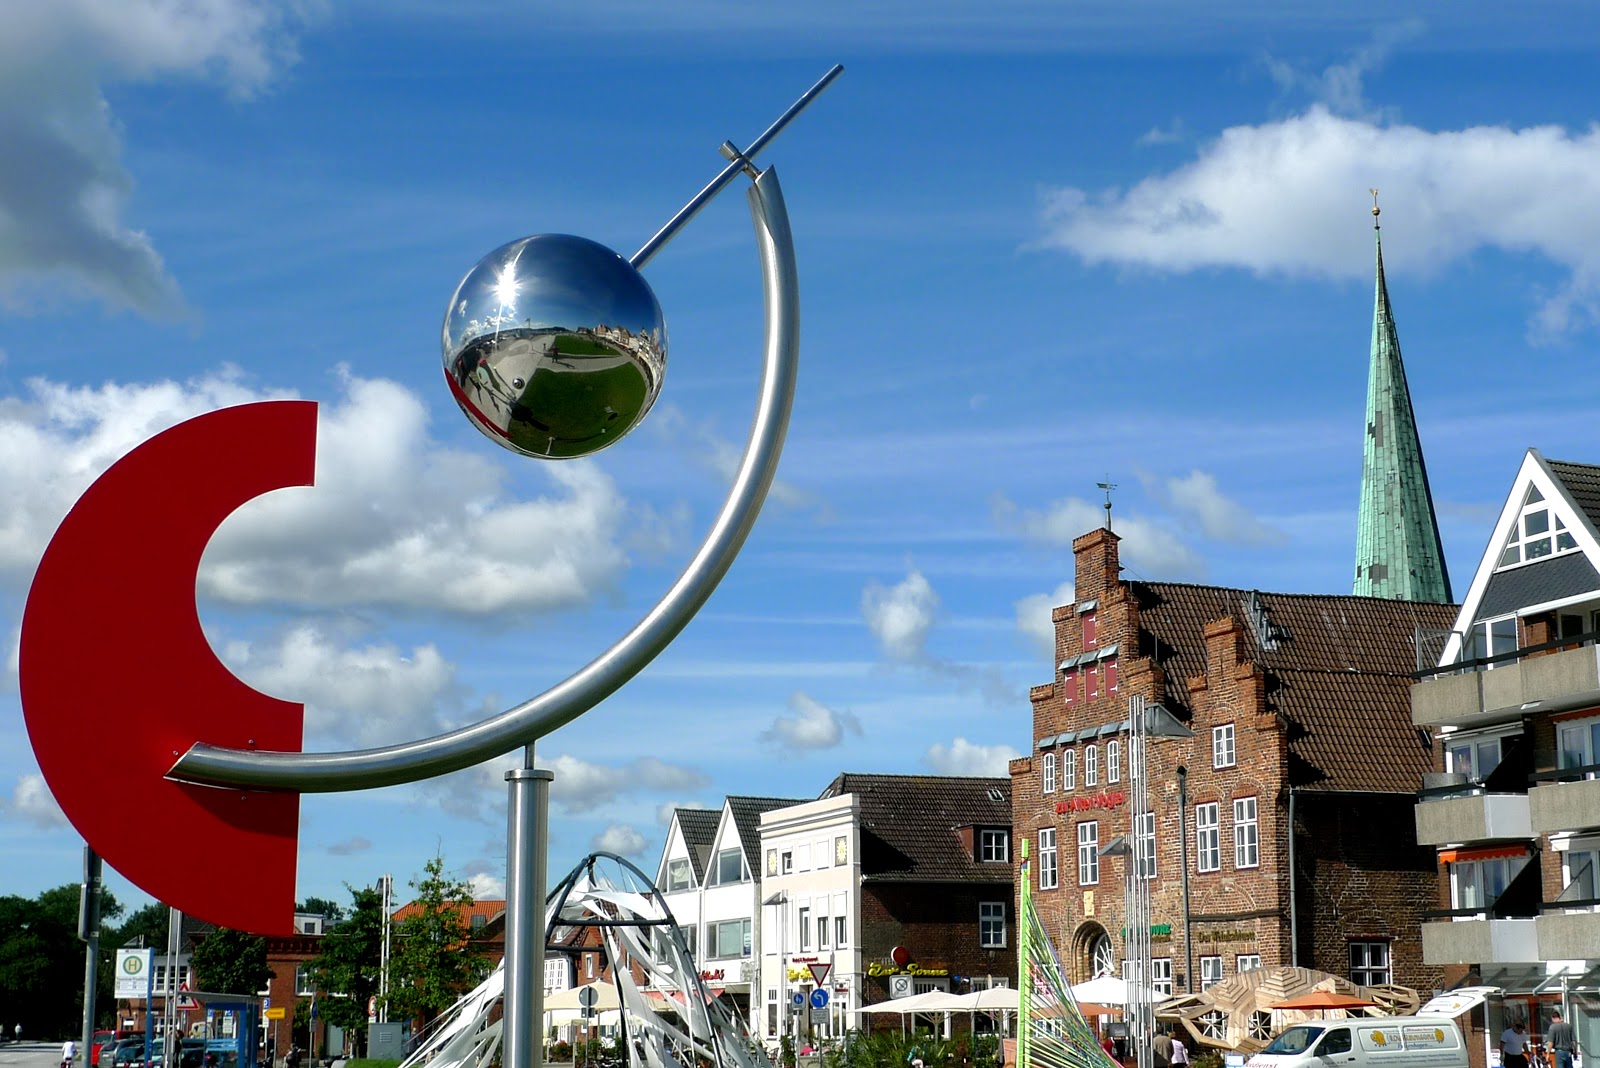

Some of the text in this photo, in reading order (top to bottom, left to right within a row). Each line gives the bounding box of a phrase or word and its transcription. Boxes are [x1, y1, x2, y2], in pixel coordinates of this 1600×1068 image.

[128, 960, 137, 971] H
[868, 962, 949, 977] Zur Sonne
